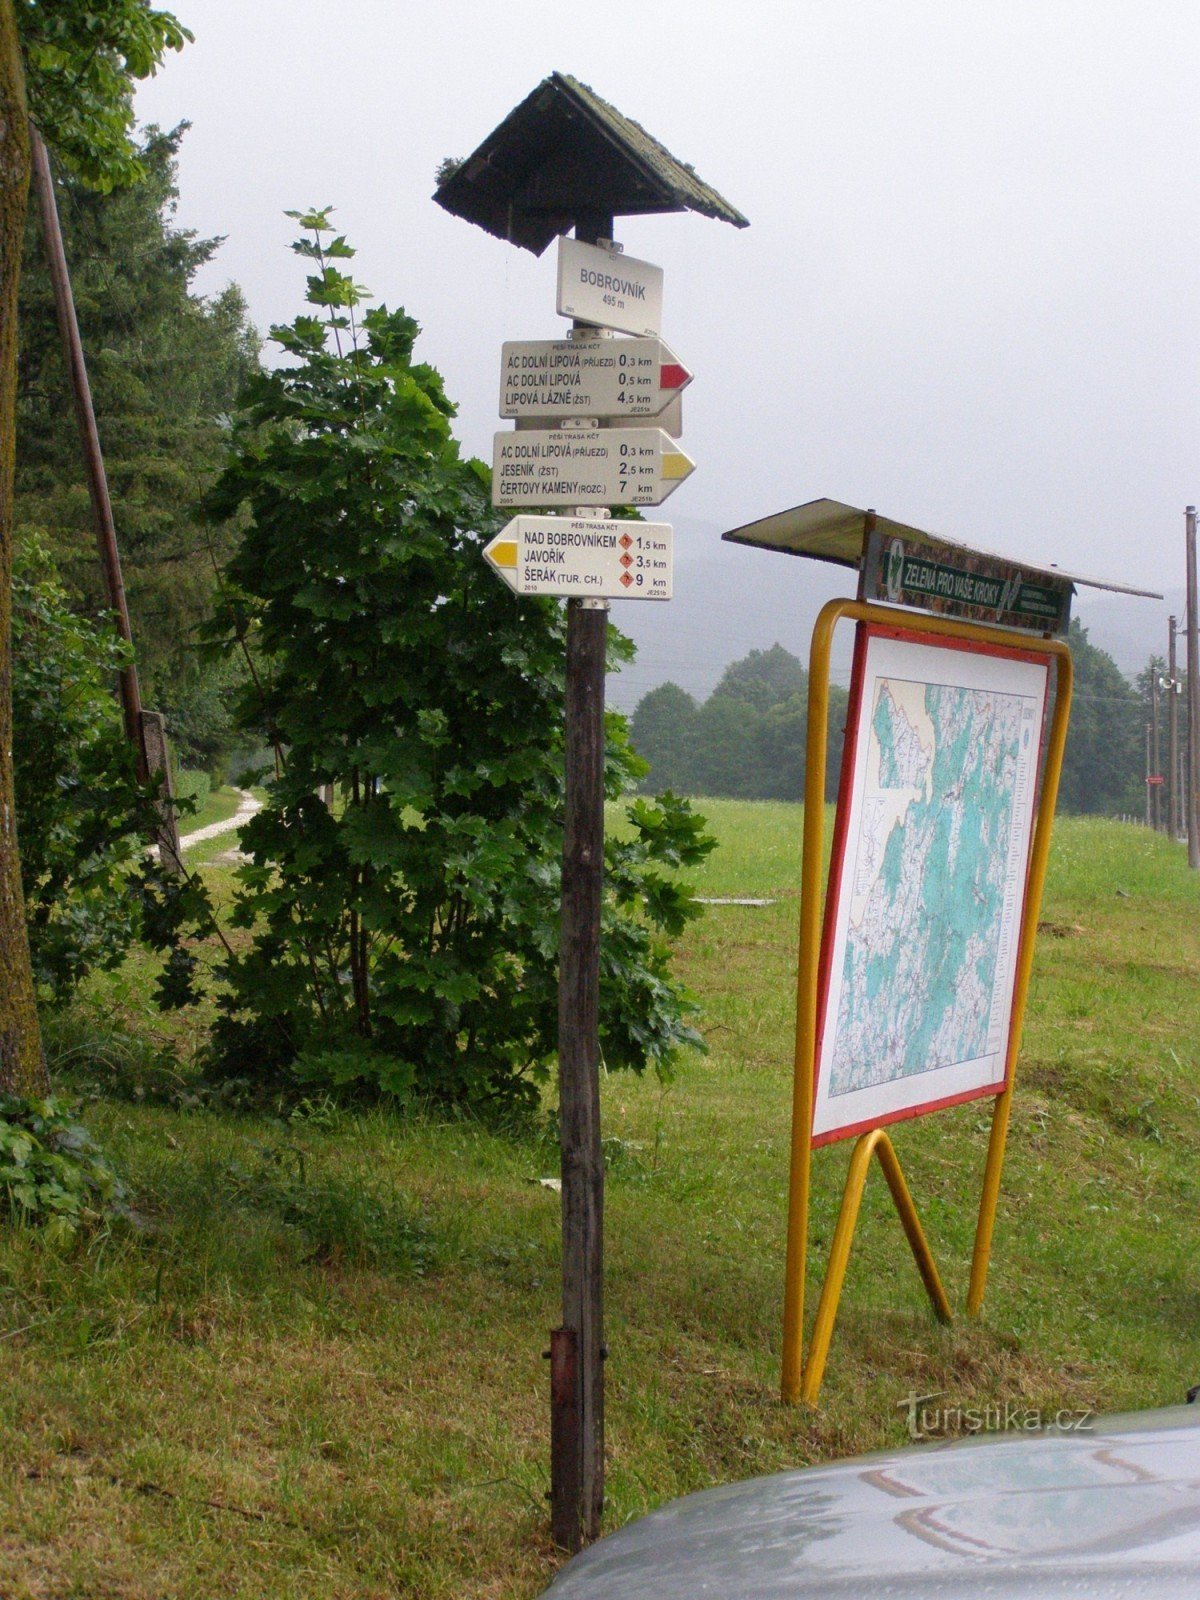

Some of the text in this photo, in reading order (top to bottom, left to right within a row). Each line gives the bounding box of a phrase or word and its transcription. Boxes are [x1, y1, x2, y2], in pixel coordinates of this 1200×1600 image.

[580, 268, 646, 300] BOBROVNÍK
[603, 294, 624, 309] 495 m
[522, 353, 548, 368] DOLNÍ
[549, 352, 580, 368] LIPOVÁ
[581, 357, 616, 368] (PŘÍJEZD)
[619, 354, 635, 367] 0,3
[638, 358, 652, 366] km
[507, 371, 651, 386] AC DOLNÍ LIPOVÁ 0,5 km
[506, 390, 539, 405] LIPOVÁ
[542, 389, 571, 404] LÁZNĚ
[573, 396, 591, 405] (ŽST)
[617, 392, 634, 404] 4,5
[501, 446, 513, 458] AC
[515, 443, 540, 458] DOLNÍ
[542, 442, 571, 457] LIPOVÁ
[572, 447, 608, 458] (PŘÍJEZD)
[620, 444, 636, 457] 0,3
[500, 462, 654, 476] JESENÍK (ŽST) 2,5 km
[500, 480, 653, 495] ČERTOVY KAMENY (ROZC.) 7 km
[524, 532, 666, 550] NAD BOBROVNÍKEM 1,5 km
[524, 549, 666, 568] JAVOŘÍK 3,5 km
[524, 566, 666, 587] ŠERÁK (TUR. CH.) 9 km
[904, 563, 937, 590] ZELENÁ
[937, 571, 954, 594] PRO
[954, 573, 974, 598] VAŠE
[974, 580, 1000, 604] KROKY
